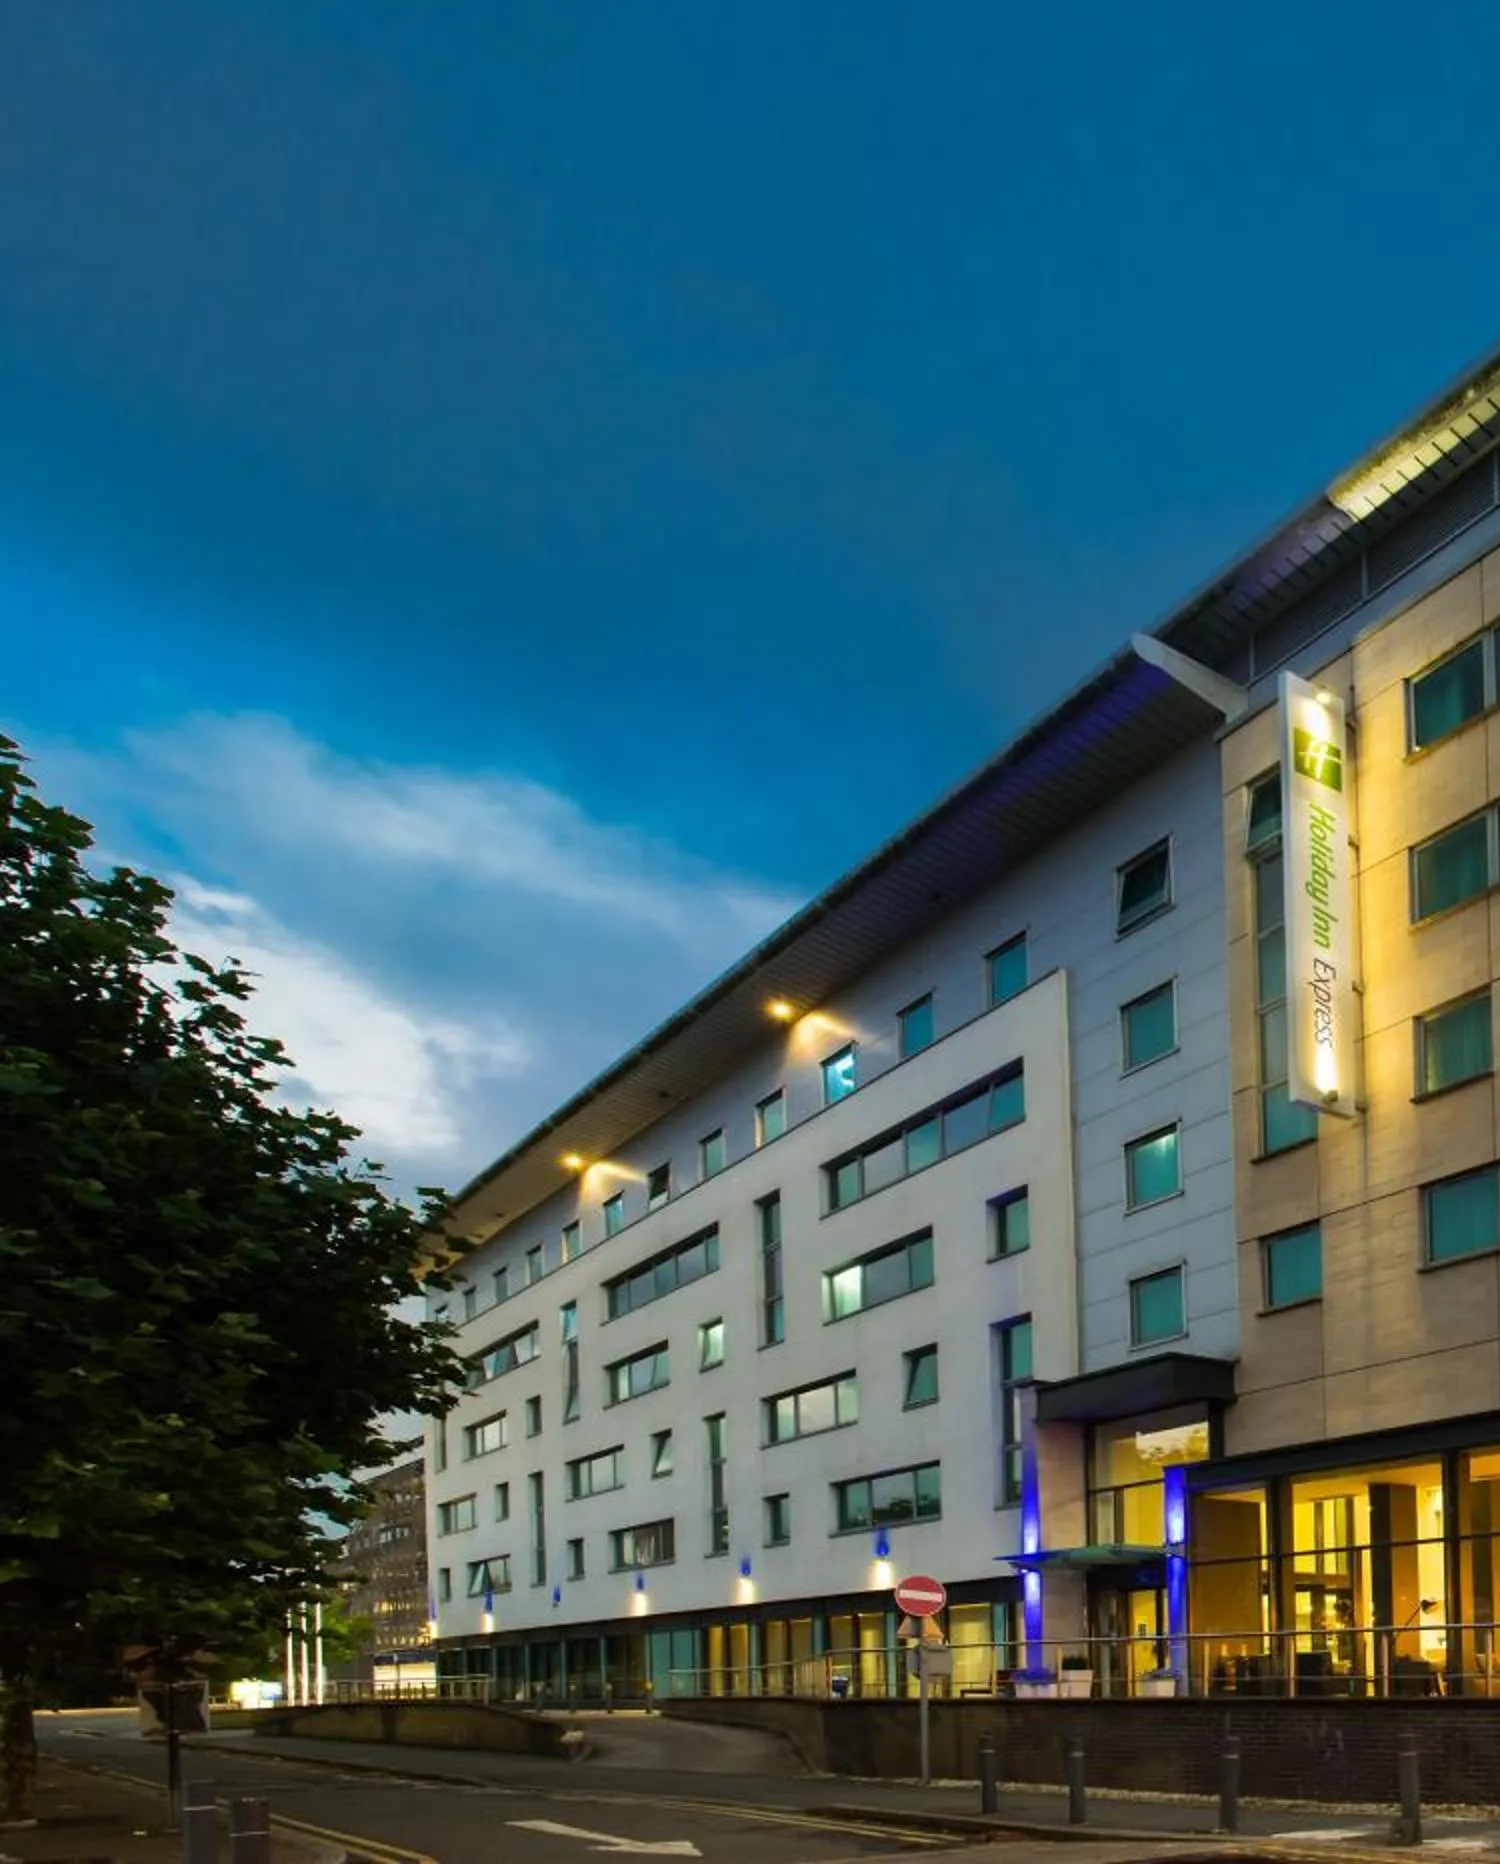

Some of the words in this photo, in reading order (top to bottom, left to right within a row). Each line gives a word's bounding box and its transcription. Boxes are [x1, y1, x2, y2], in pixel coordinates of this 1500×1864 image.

[1306, 803, 1336, 906] Holiday
[1313, 905, 1339, 949] Inn
[1307, 957, 1337, 1048] Express
